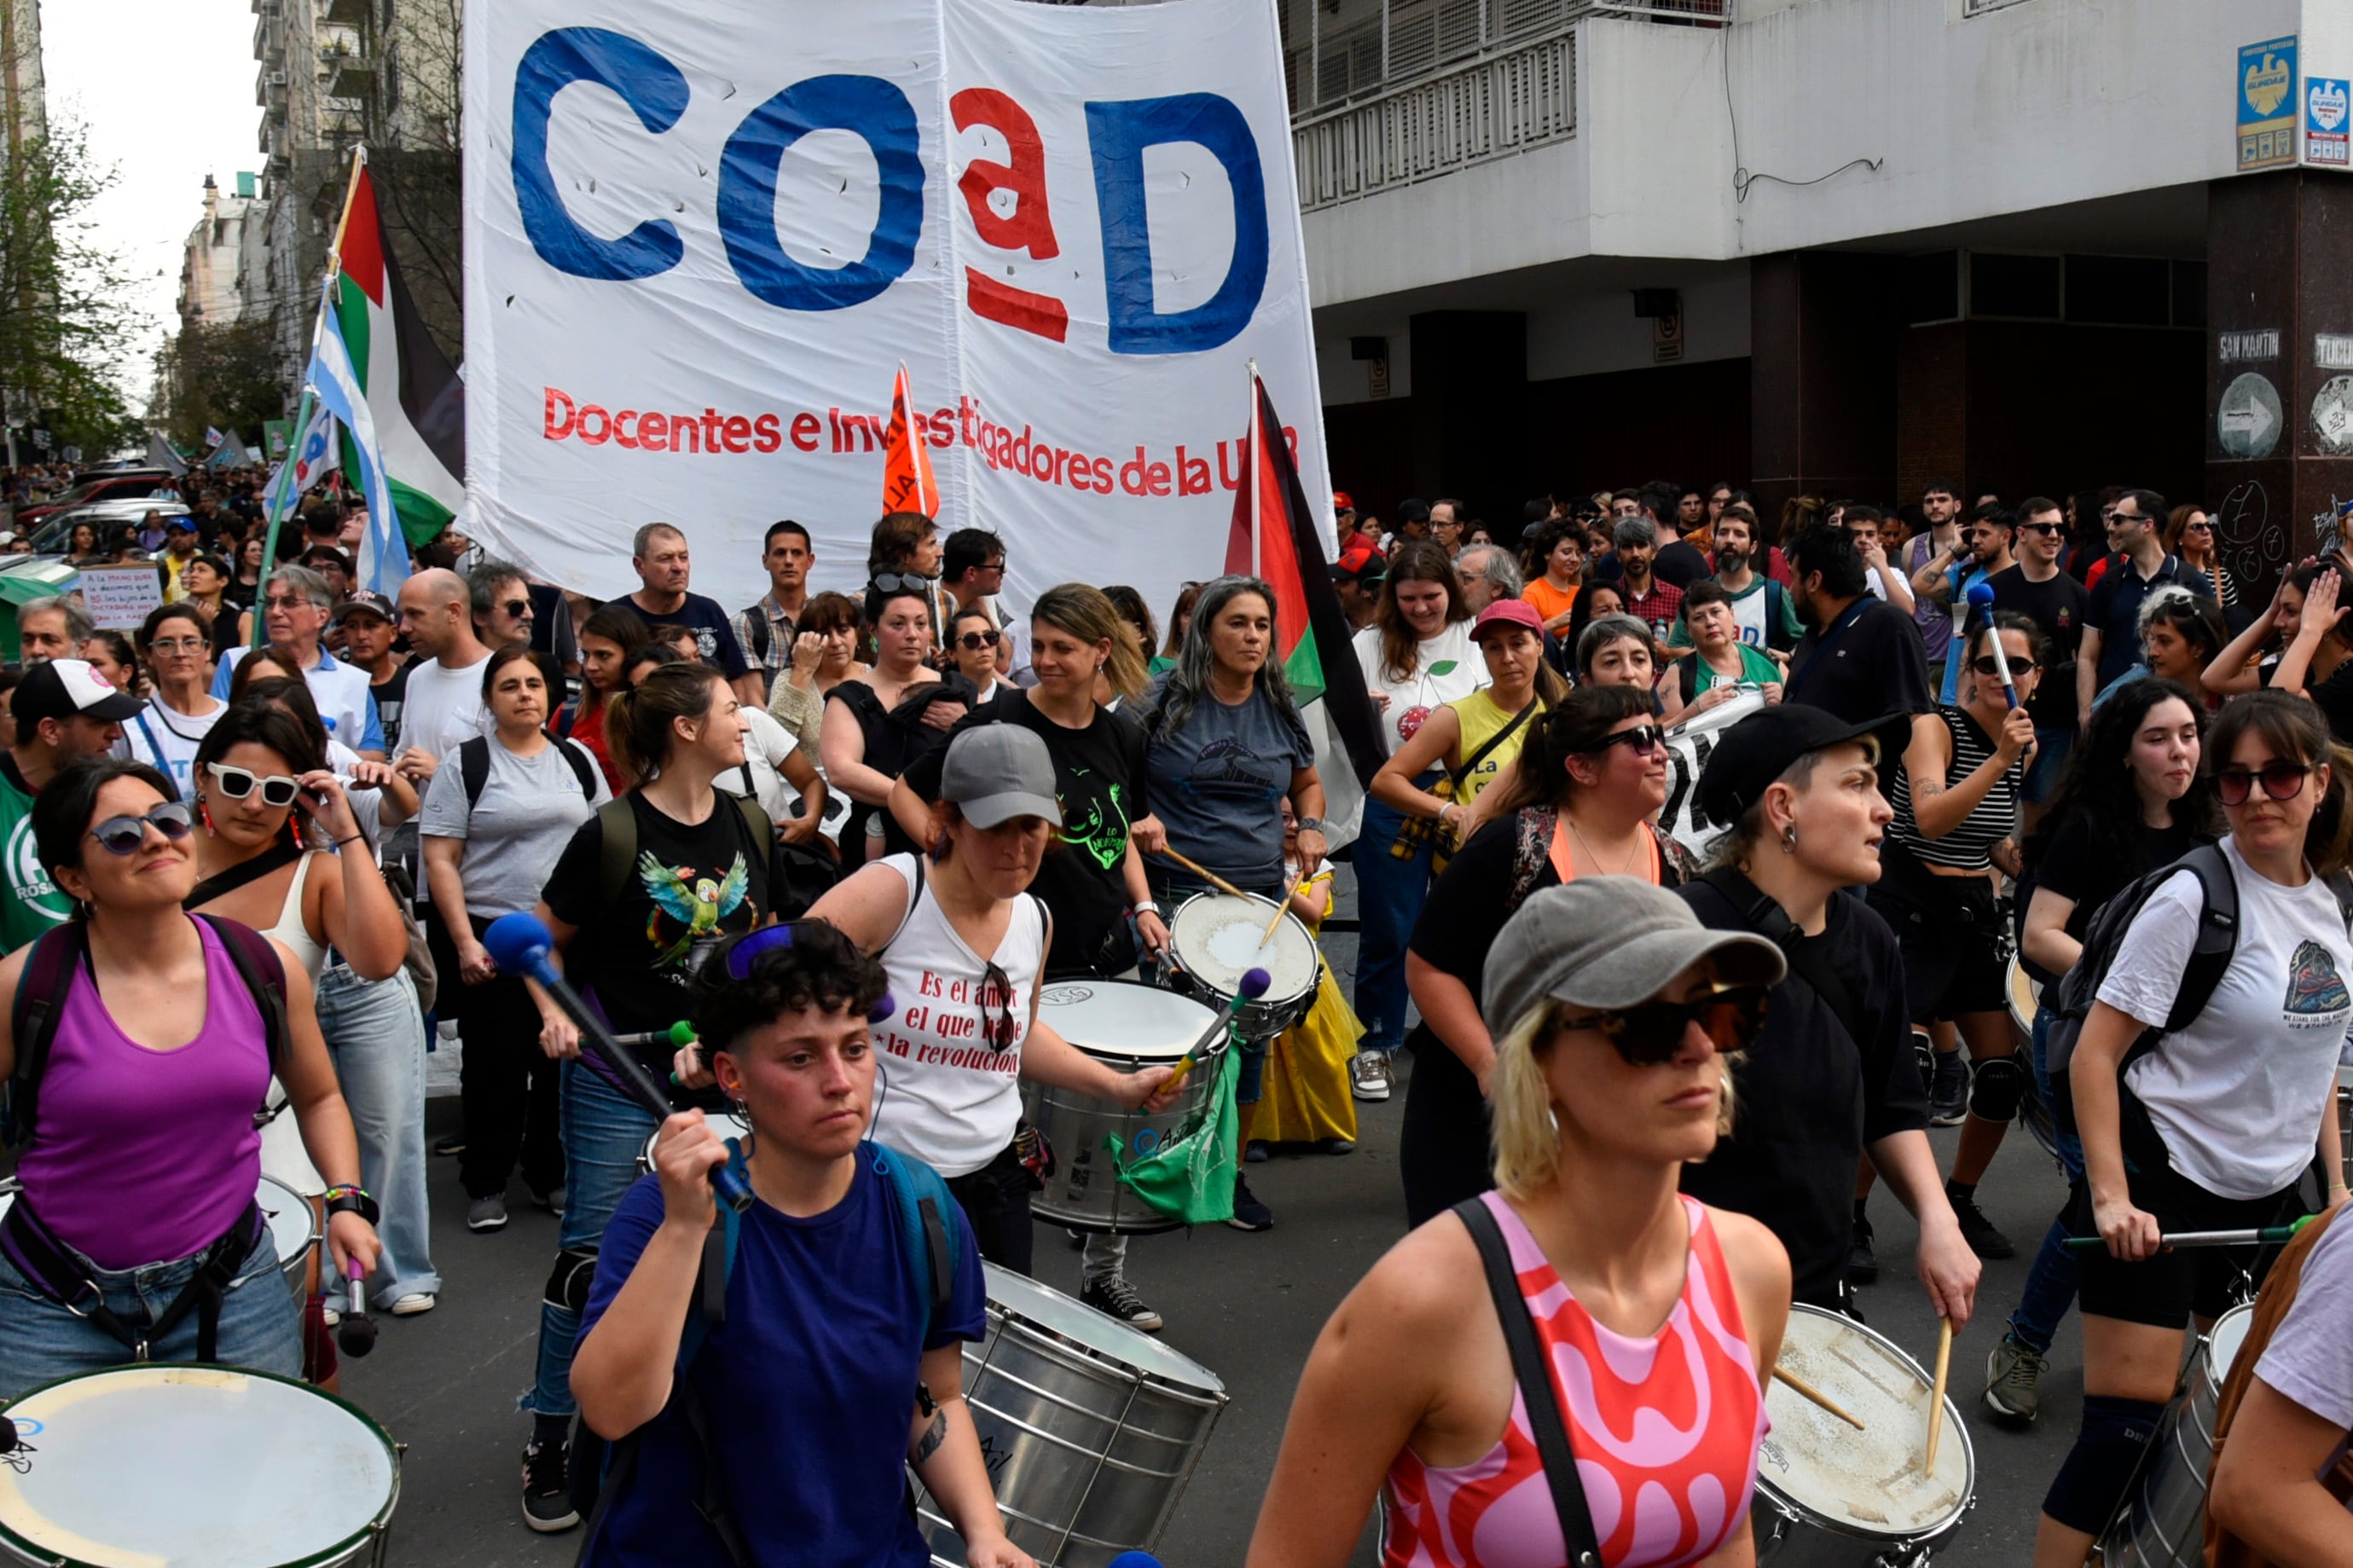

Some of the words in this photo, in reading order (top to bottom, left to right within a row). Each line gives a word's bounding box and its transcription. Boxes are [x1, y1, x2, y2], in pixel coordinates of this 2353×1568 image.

[2220, 335, 2240, 360] SAN
[2241, 332, 2279, 358] MARTIN
[2317, 338, 2353, 366] TUCU
[543, 386, 782, 454] Docentes
[791, 412, 821, 453] e
[1119, 444, 1171, 497] de
[1175, 445, 1213, 497] la
[88, 574, 94, 582] A
[1475, 761, 1498, 774] La
[16, 882, 57, 900] ROSA
[919, 970, 942, 999] Es
[950, 979, 968, 1004] el
[905, 1006, 929, 1032] el
[936, 1013, 975, 1039] que
[886, 1033, 910, 1060] la
[916, 1044, 1017, 1073] revolución
